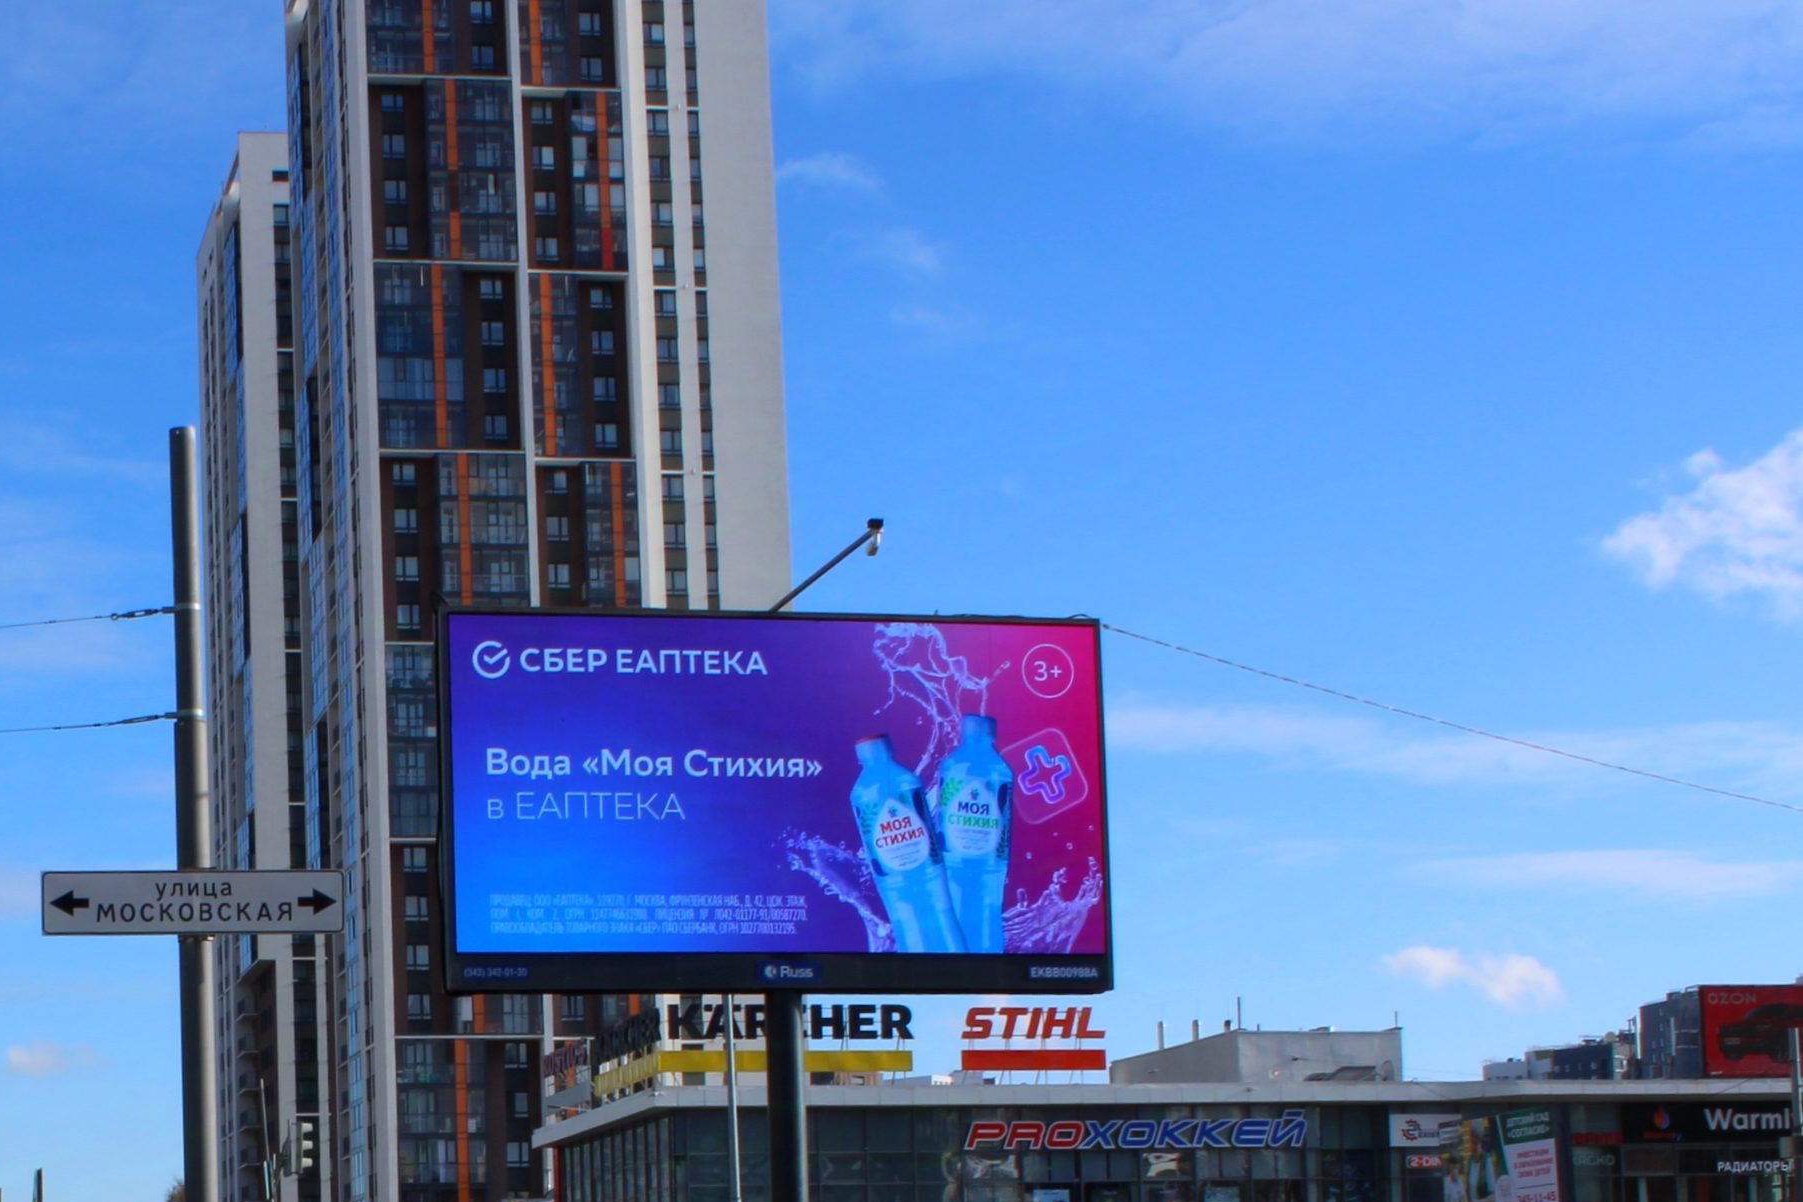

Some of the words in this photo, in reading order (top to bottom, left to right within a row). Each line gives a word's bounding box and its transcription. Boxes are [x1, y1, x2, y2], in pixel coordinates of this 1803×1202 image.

[519, 647, 608, 674] СБЕР
[616, 649, 769, 676] ЕАПТЕКА
[1032, 660, 1063, 682] 3+
[485, 748, 572, 779] Вода
[582, 748, 674, 778] «Моя
[683, 749, 824, 779] Стихия»
[486, 800, 505, 819] в
[516, 793, 686, 820] ЕАПТЕКА
[958, 801, 990, 815] МОЯ
[879, 816, 912, 834] МОЯ
[949, 815, 999, 829] СТИХИЯ
[875, 827, 925, 849] СТИХИЯ
[155, 882, 233, 902] улица
[96, 902, 293, 924] МОСКОВСКАЯ
[780, 966, 813, 978] Russ
[1708, 992, 1757, 1004] OZON
[667, 1003, 915, 1040] KÄRHER
[962, 1007, 1106, 1039] STIHL
[1703, 1107, 1793, 1130] Warml
